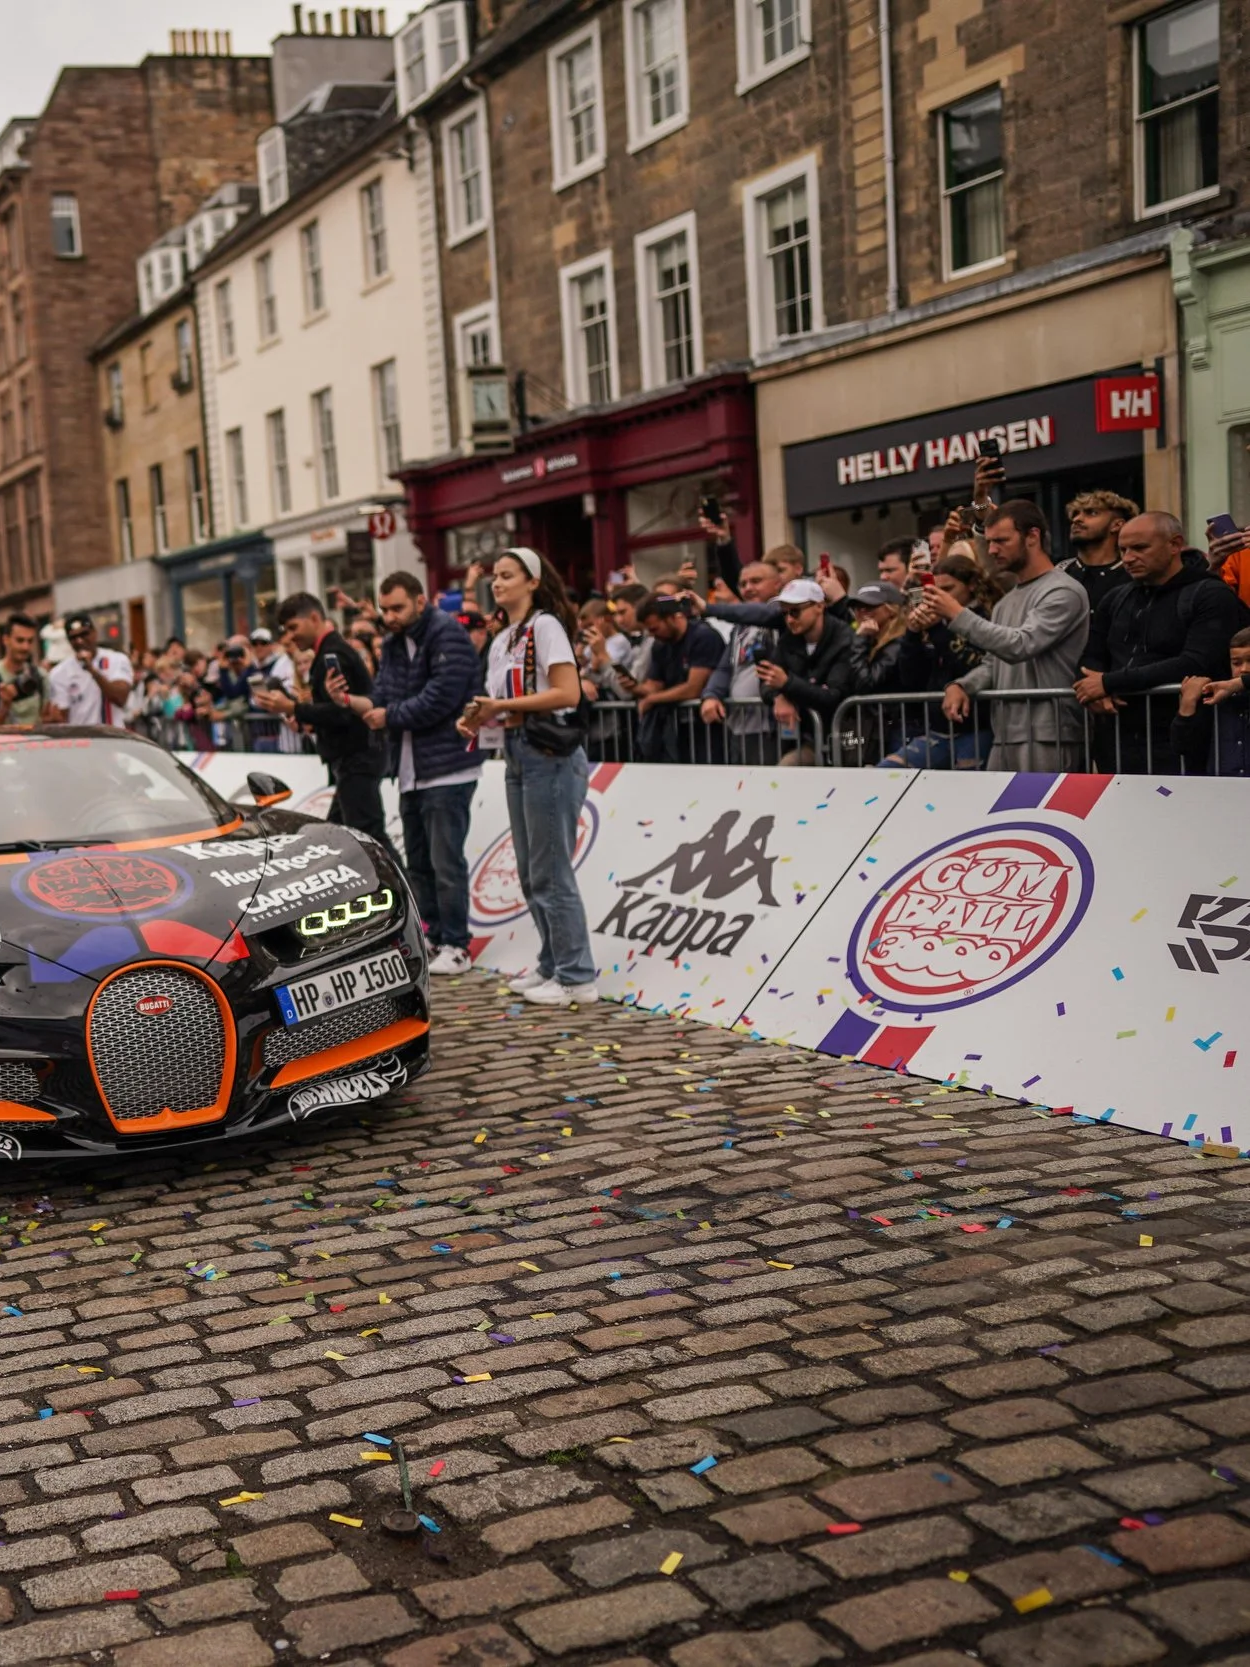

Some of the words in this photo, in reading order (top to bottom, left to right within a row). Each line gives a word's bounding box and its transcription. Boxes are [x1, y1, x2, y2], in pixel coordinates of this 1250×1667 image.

[1110, 389, 1152, 418] HH
[837, 442, 920, 486] HELLY
[925, 415, 1055, 469] HANSEN
[170, 834, 306, 860] Kappa
[210, 858, 279, 888] Hard
[276, 843, 342, 871] Rock
[237, 864, 362, 914] CARRERA
[919, 853, 1074, 902] GUM
[592, 889, 756, 961] Kappa
[883, 890, 1049, 948] BALL
[862, 929, 1014, 982] 3000
[140, 1000, 170, 1011] BUGATTI
[291, 983, 320, 1017] HP
[330, 970, 357, 1003] HP
[359, 954, 408, 994] 1500
[286, 1009, 293, 1019] D
